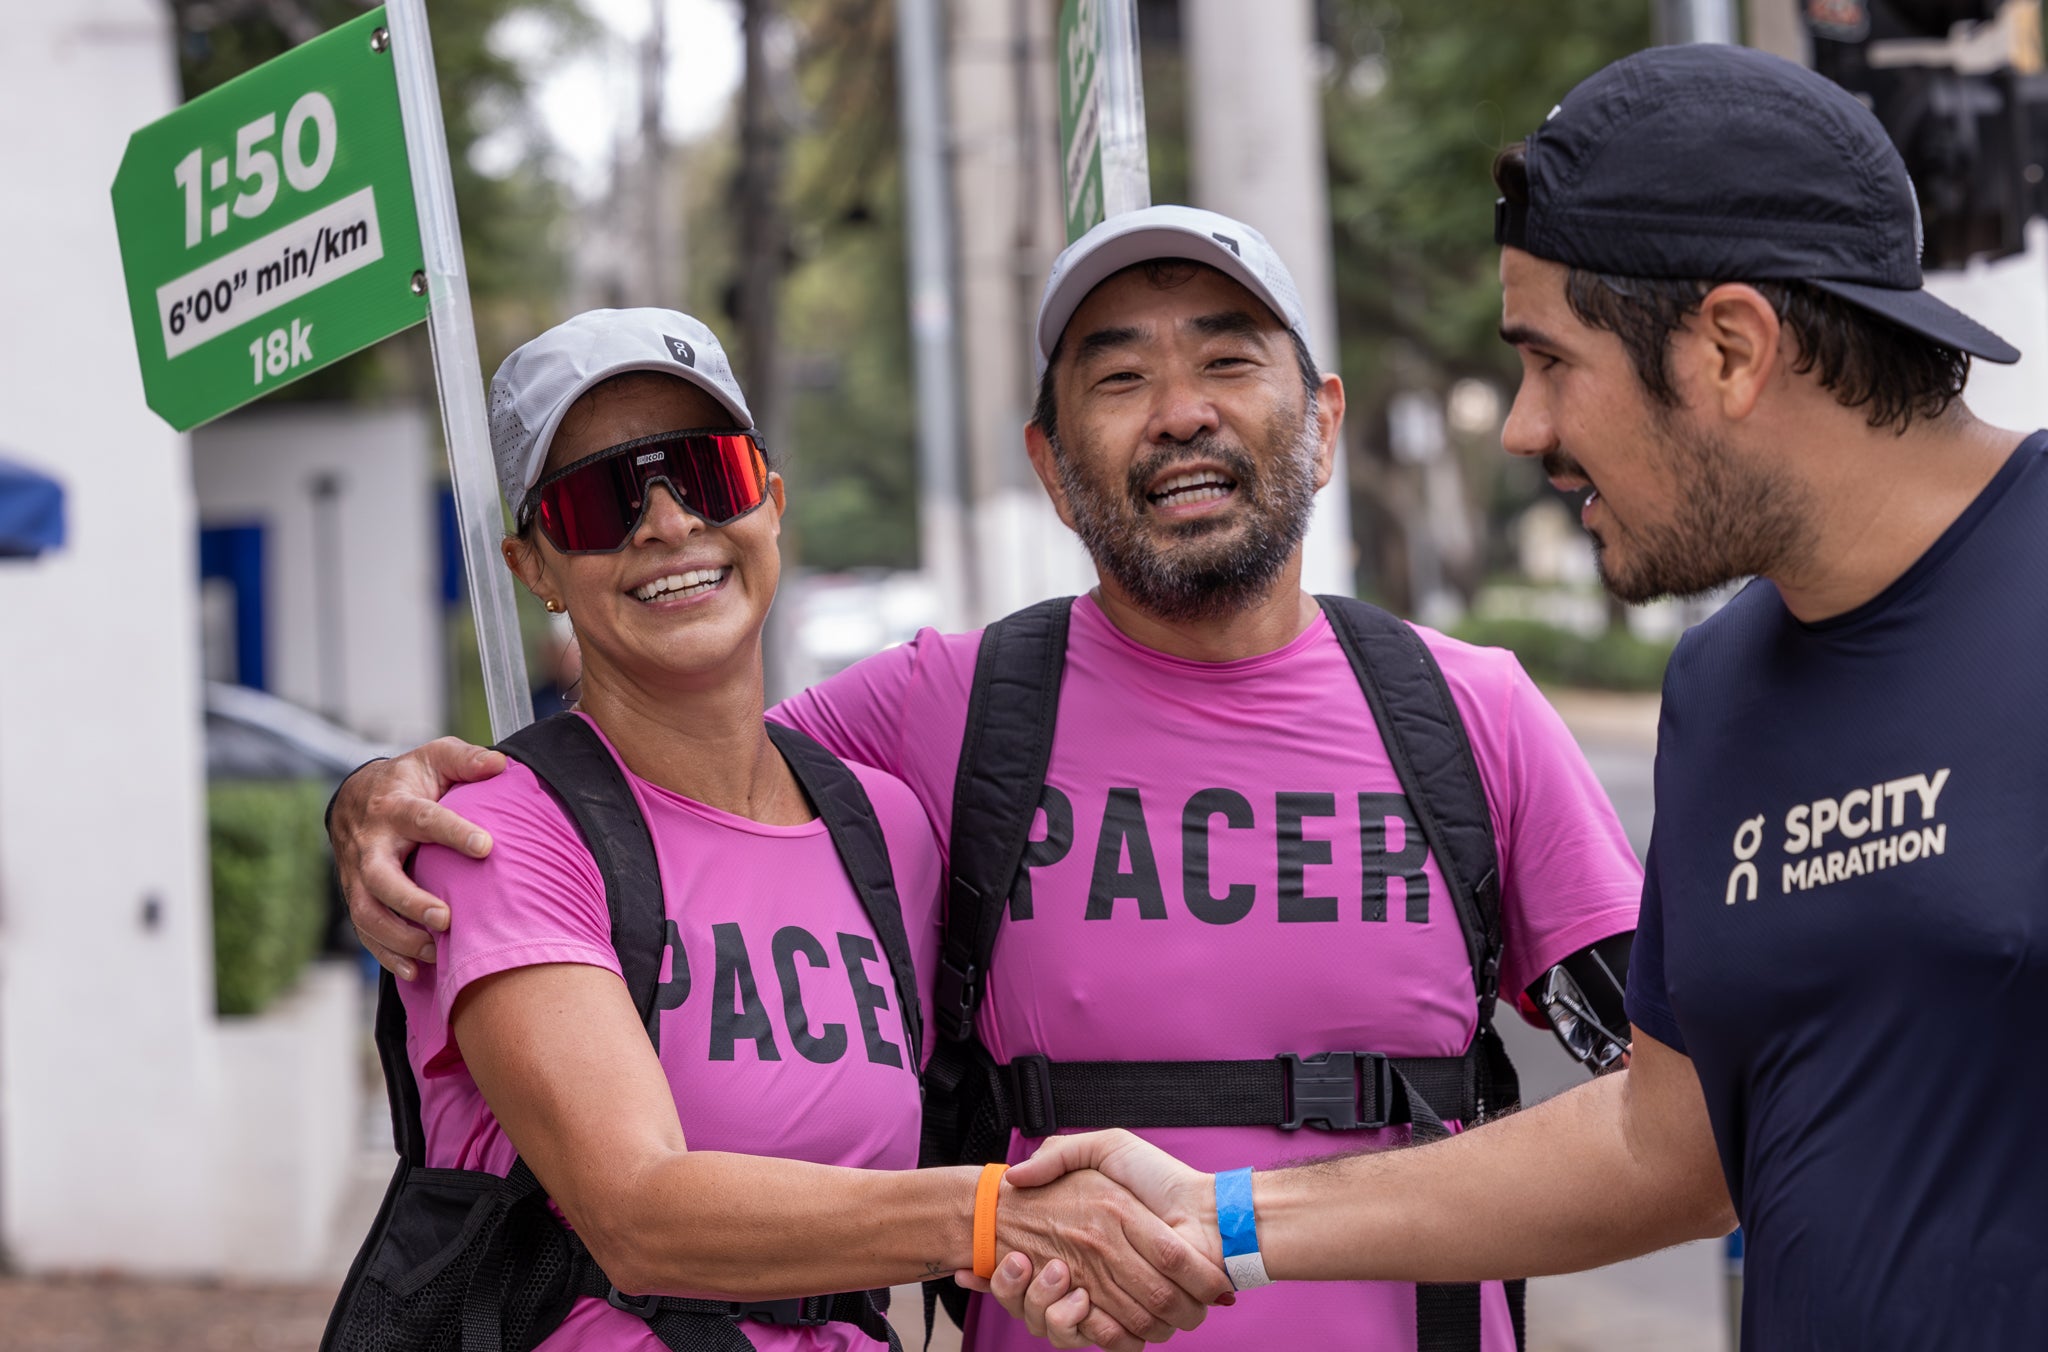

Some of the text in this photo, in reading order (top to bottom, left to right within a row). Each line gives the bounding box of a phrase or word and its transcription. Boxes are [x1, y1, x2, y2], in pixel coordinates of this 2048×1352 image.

[174, 91, 338, 250] 1:50
[255, 218, 368, 296] min/km
[248, 317, 314, 386] 18k
[1782, 767, 1951, 854] SPCITY
[1008, 784, 1431, 926] PACER
[1781, 823, 1947, 894] MARATHON
